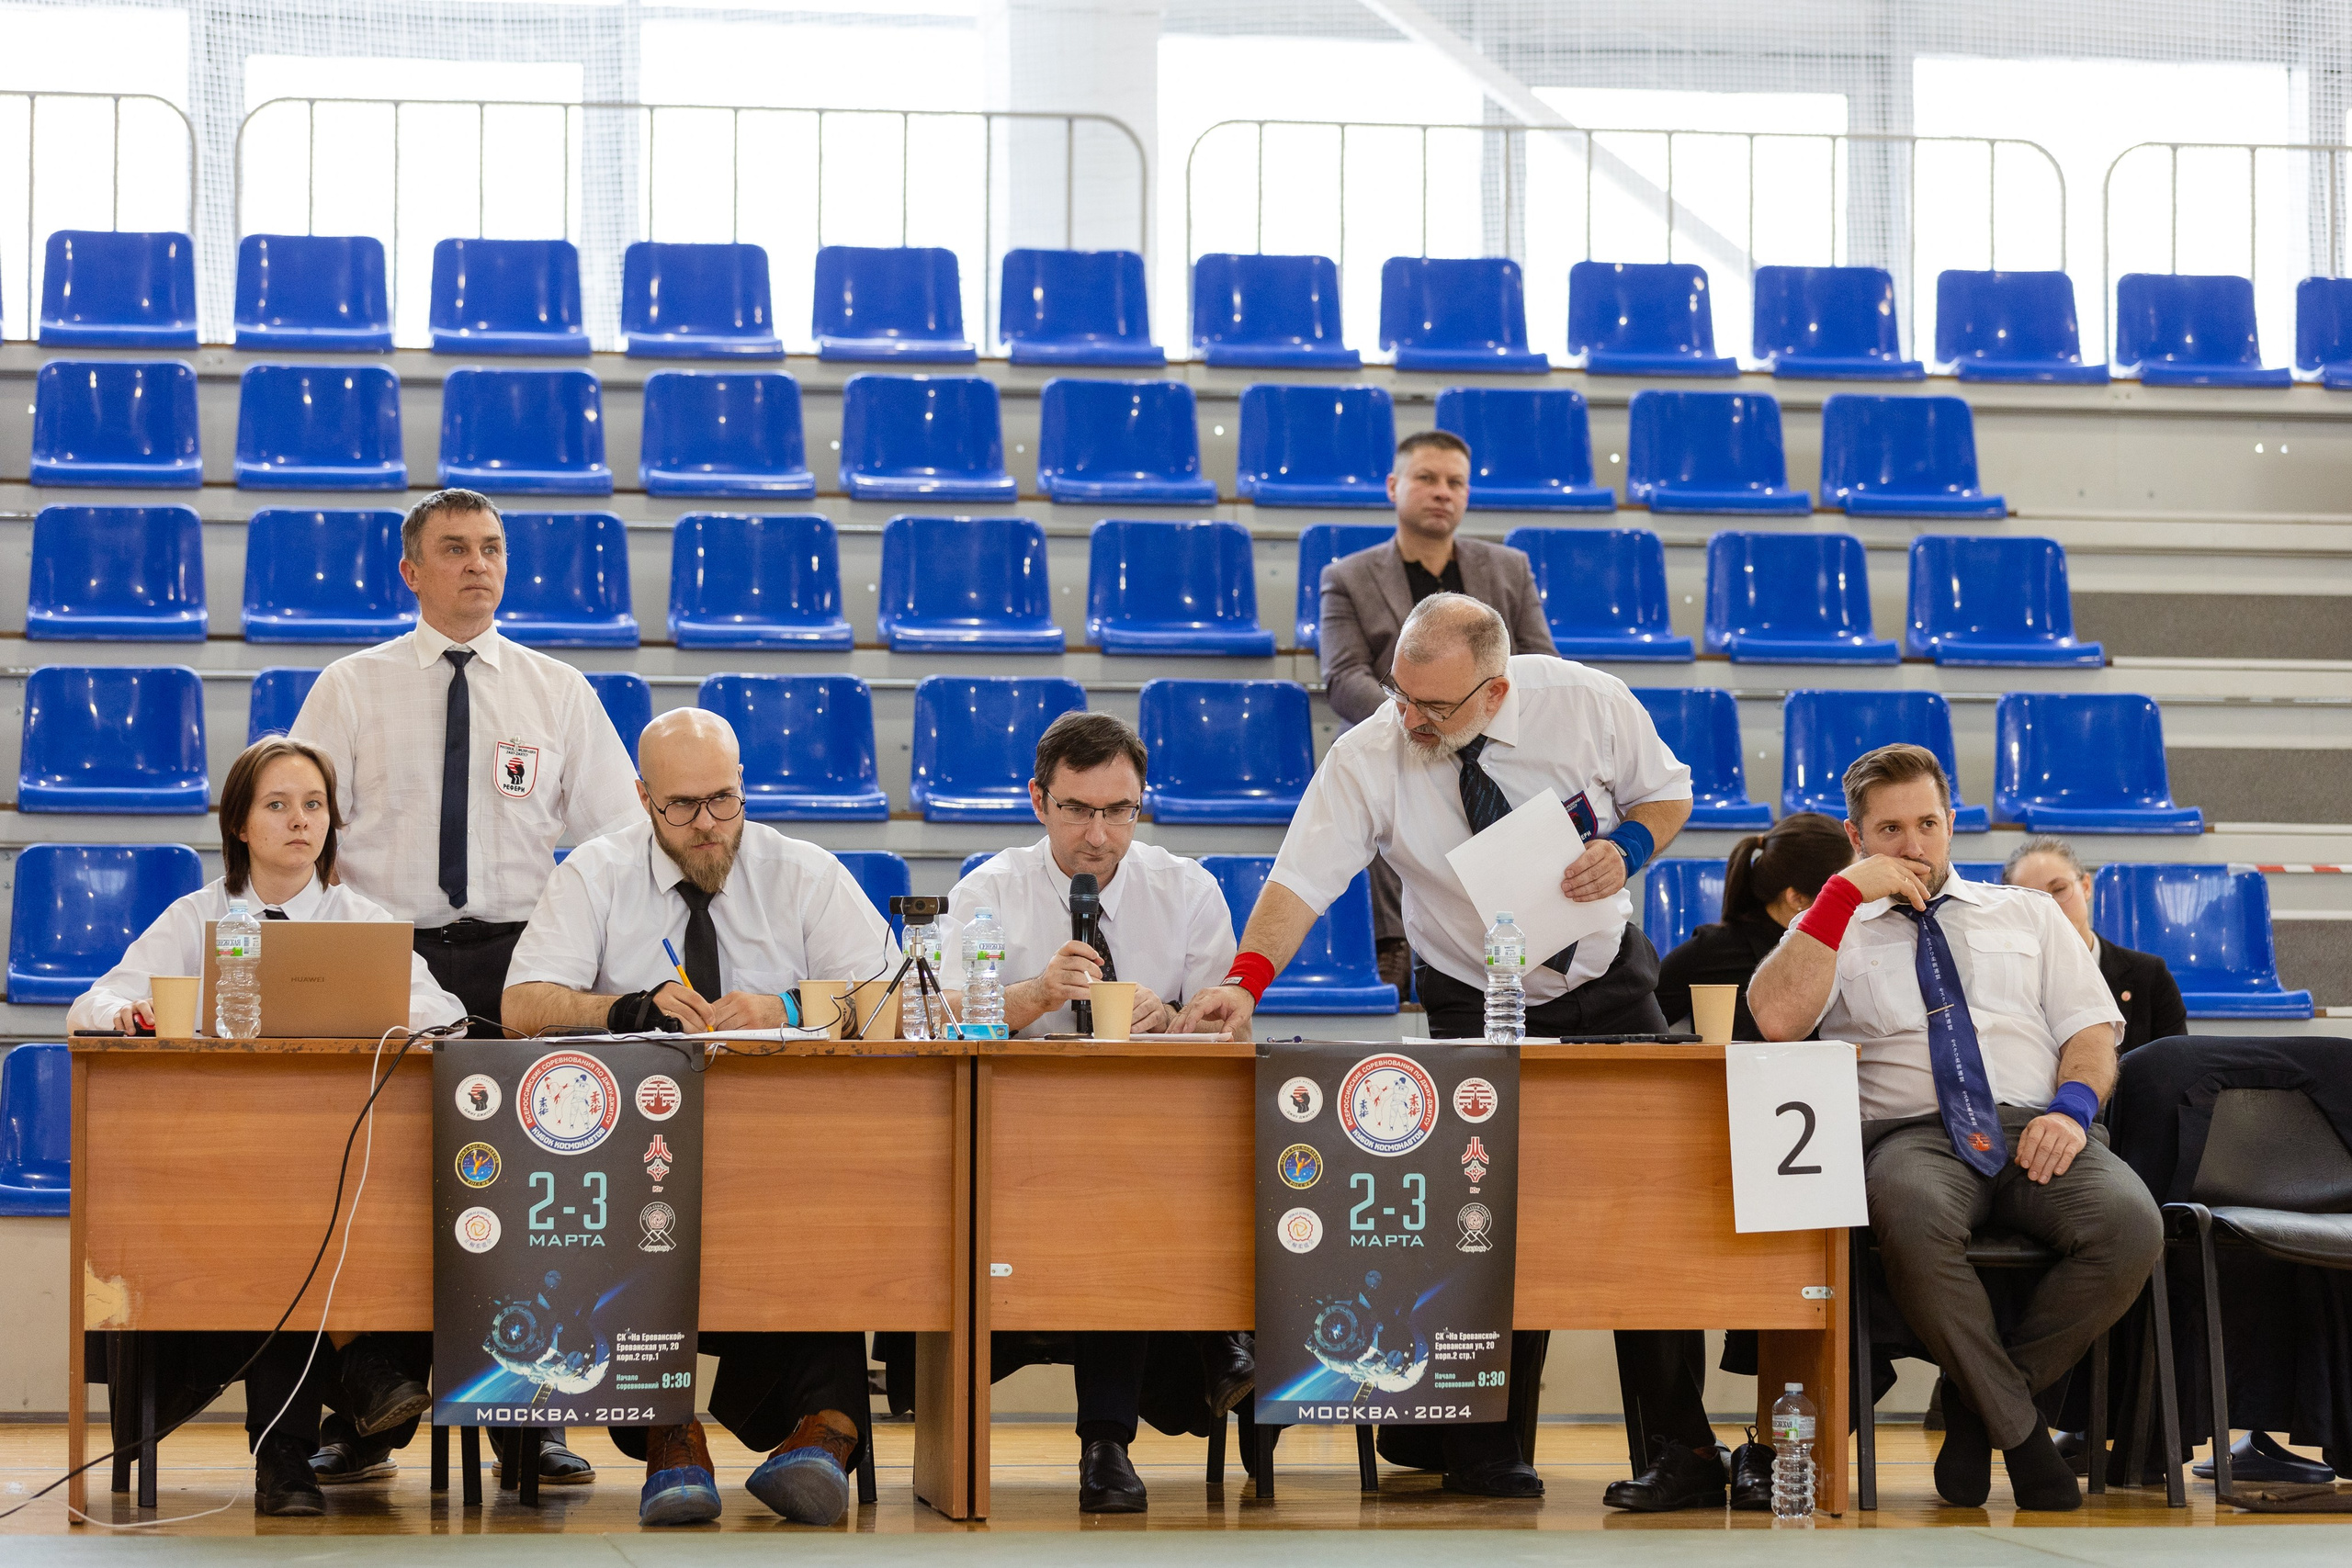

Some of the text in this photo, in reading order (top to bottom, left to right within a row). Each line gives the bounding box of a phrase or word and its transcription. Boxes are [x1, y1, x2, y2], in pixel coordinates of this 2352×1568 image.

[503, 784, 526, 793] РЕФЕРИ
[523, 1056, 616, 1124] ВСЕРОССИЙСКИЕ СОРЕВНОВАНИЯ ПО ДЖИУ-ДЖИТСУ
[1343, 1059, 1433, 1127] ВСЕРОССИЙСКИЕ СОРЕВНОВАНИЯ ПО ДЖИУ-ДЖИТСУ
[531, 1127, 605, 1150] КУБОК КОСМОНАВТОВ
[1351, 1129, 1425, 1152] КУБОК КОСМОНАВТОВ
[1775, 1100, 1822, 1176] 2
[528, 1171, 607, 1230] 2-3
[1350, 1173, 1426, 1231] 2-3
[529, 1234, 606, 1247] МАРТА
[1351, 1235, 1424, 1247] МАРТА
[616, 1332, 684, 1342] СК «На Ереванской»
[1435, 1331, 1500, 1341] СК «На Ереванской»
[616, 1342, 679, 1352] Ереванская ул, 20
[1435, 1341, 1495, 1351] Ереванская ул, 20
[616, 1352, 659, 1362] корп.2 стр.1
[1435, 1351, 1476, 1361] корп.2 стр.1
[616, 1373, 639, 1382] Начало
[662, 1371, 691, 1389] 9:30
[1434, 1372, 1456, 1381] Начало
[1477, 1371, 1506, 1387] 9:30
[616, 1381, 659, 1390] соревнований
[1434, 1379, 1476, 1389] соревнований
[476, 1407, 656, 1421] МОСКВА 2024
[1298, 1405, 1472, 1419] МОСКВА 2024
